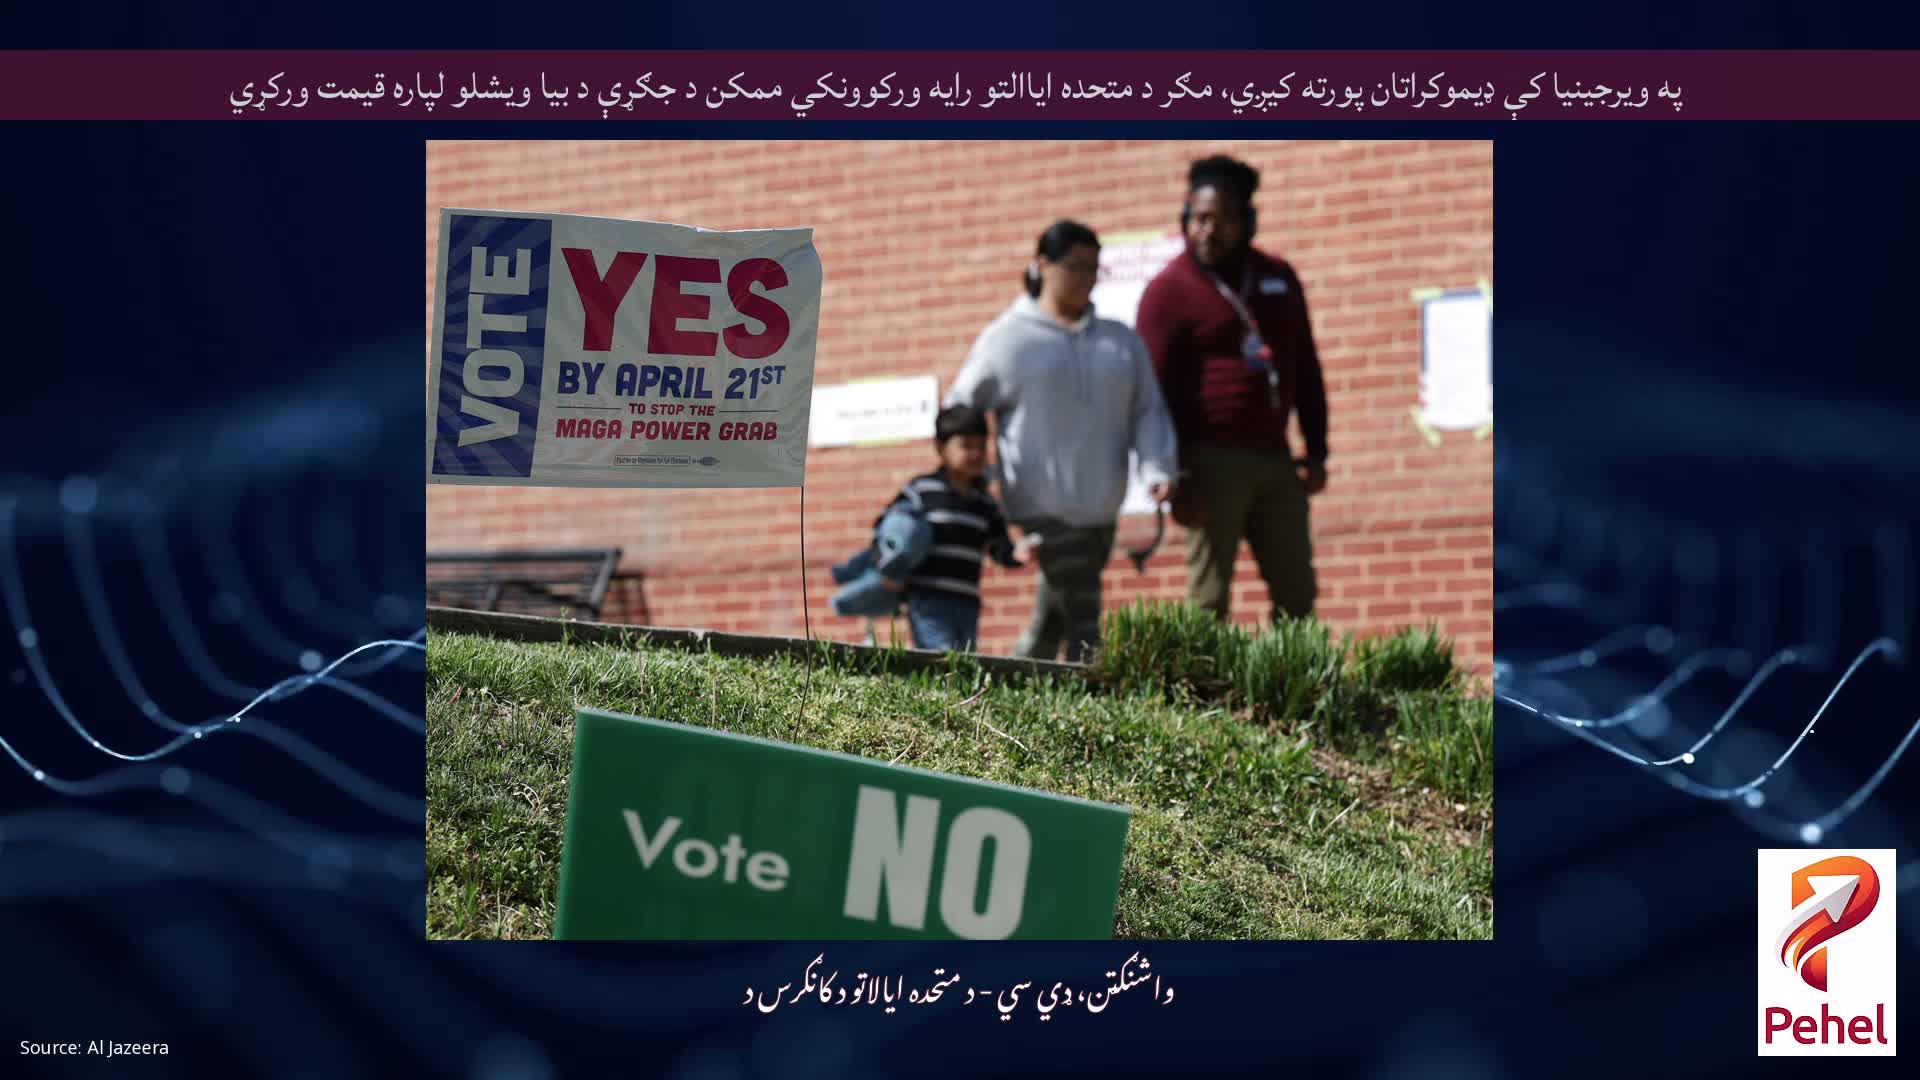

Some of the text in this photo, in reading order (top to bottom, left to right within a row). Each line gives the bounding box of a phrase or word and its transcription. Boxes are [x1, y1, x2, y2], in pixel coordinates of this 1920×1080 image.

[561, 247, 791, 360] YES
[458, 246, 532, 447] VOTE
[557, 361, 605, 396] BY
[615, 363, 713, 399] APRIL
[556, 418, 779, 442] MAGA POWER GRAB
[629, 402, 716, 417] TO STOP THE
[622, 784, 1032, 940] Vote NO
